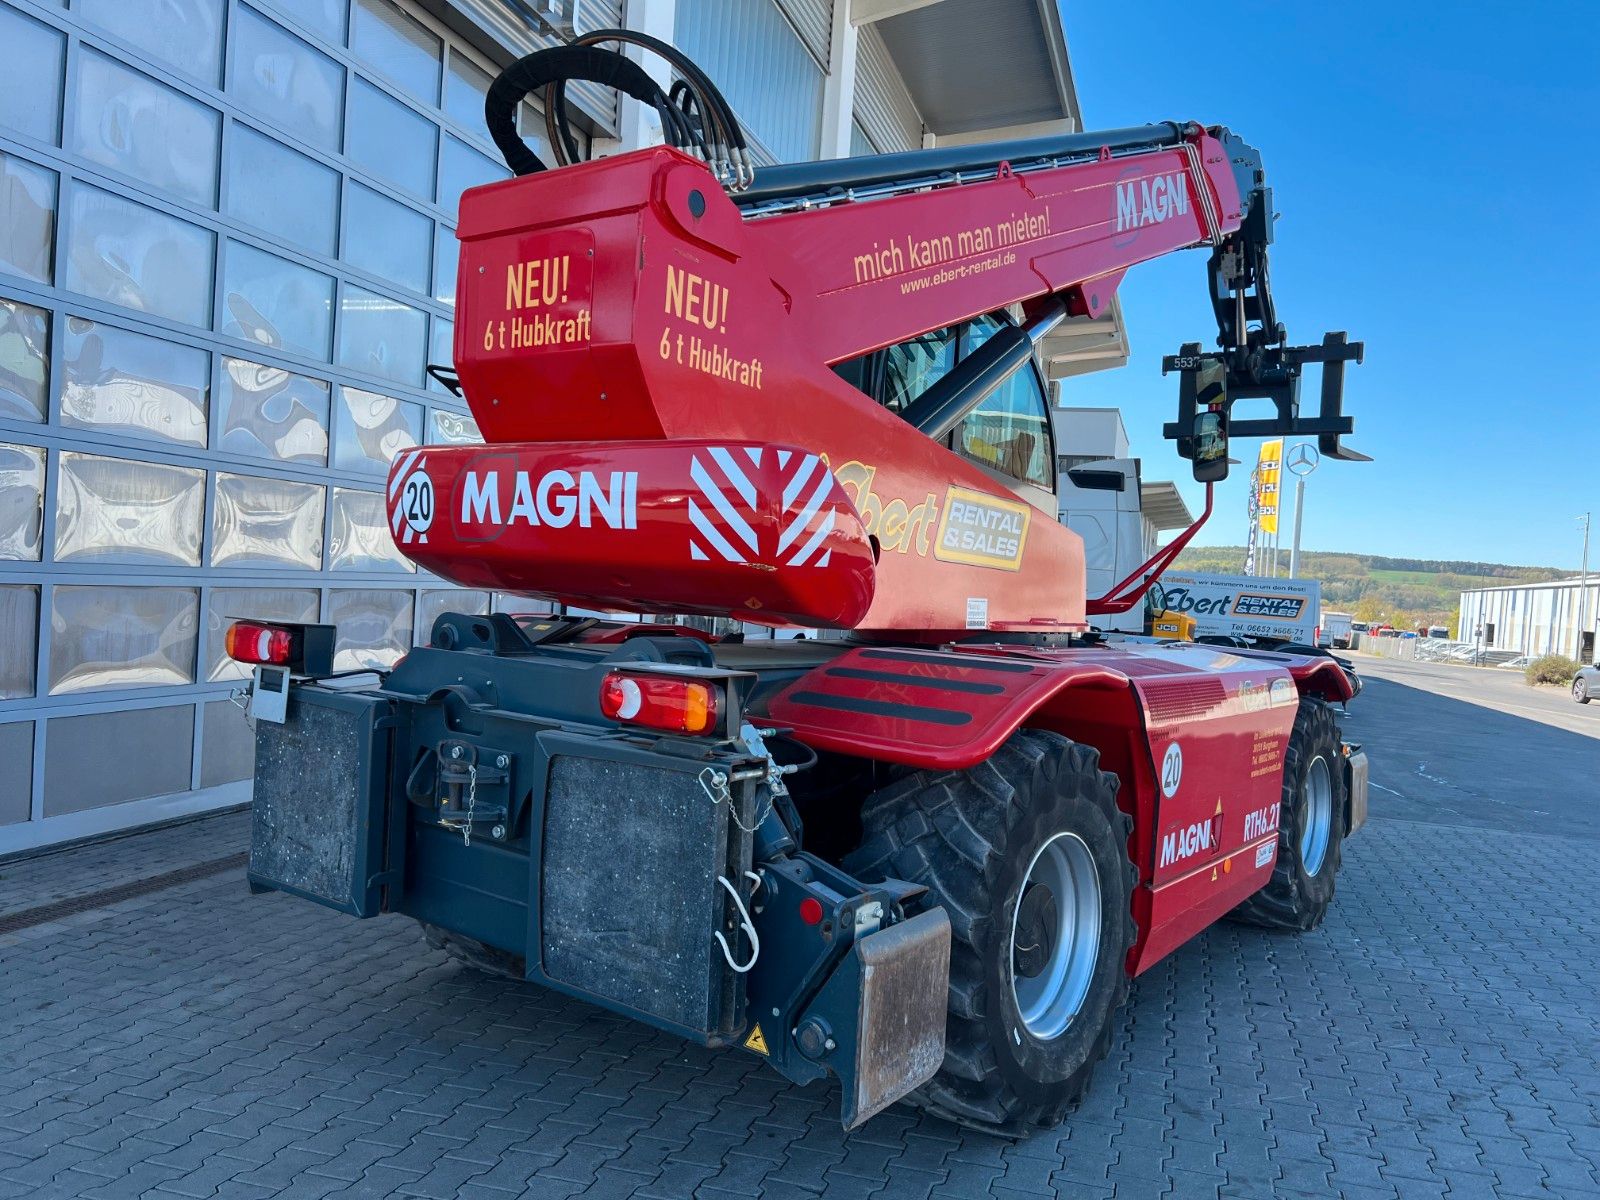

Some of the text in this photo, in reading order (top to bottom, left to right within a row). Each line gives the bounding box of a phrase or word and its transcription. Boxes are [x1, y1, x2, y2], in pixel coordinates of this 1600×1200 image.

[1116, 172, 1190, 231] MAGNI
[853, 206, 1051, 283] mich kann man mieten!
[505, 255, 570, 311] NEU!
[900, 251, 1017, 295] www.ebert-rental.de
[664, 264, 730, 335] NEU!
[484, 309, 592, 352] 6 t Hubkraft
[659, 326, 764, 391] 6 t Hubkraft
[407, 480, 432, 521] 20
[461, 468, 638, 531] MAGNI
[949, 502, 1021, 534] RENTAL
[961, 532, 1019, 557] SALES
[1164, 588, 1232, 616] Ebert
[1239, 596, 1301, 609] RENTAL
[1248, 606, 1299, 618] SALES
[1155, 624, 1179, 632] JCB
[1163, 752, 1181, 789] 20
[1243, 801, 1280, 843] RTH6.21
[1160, 818, 1212, 869] MAGNI
